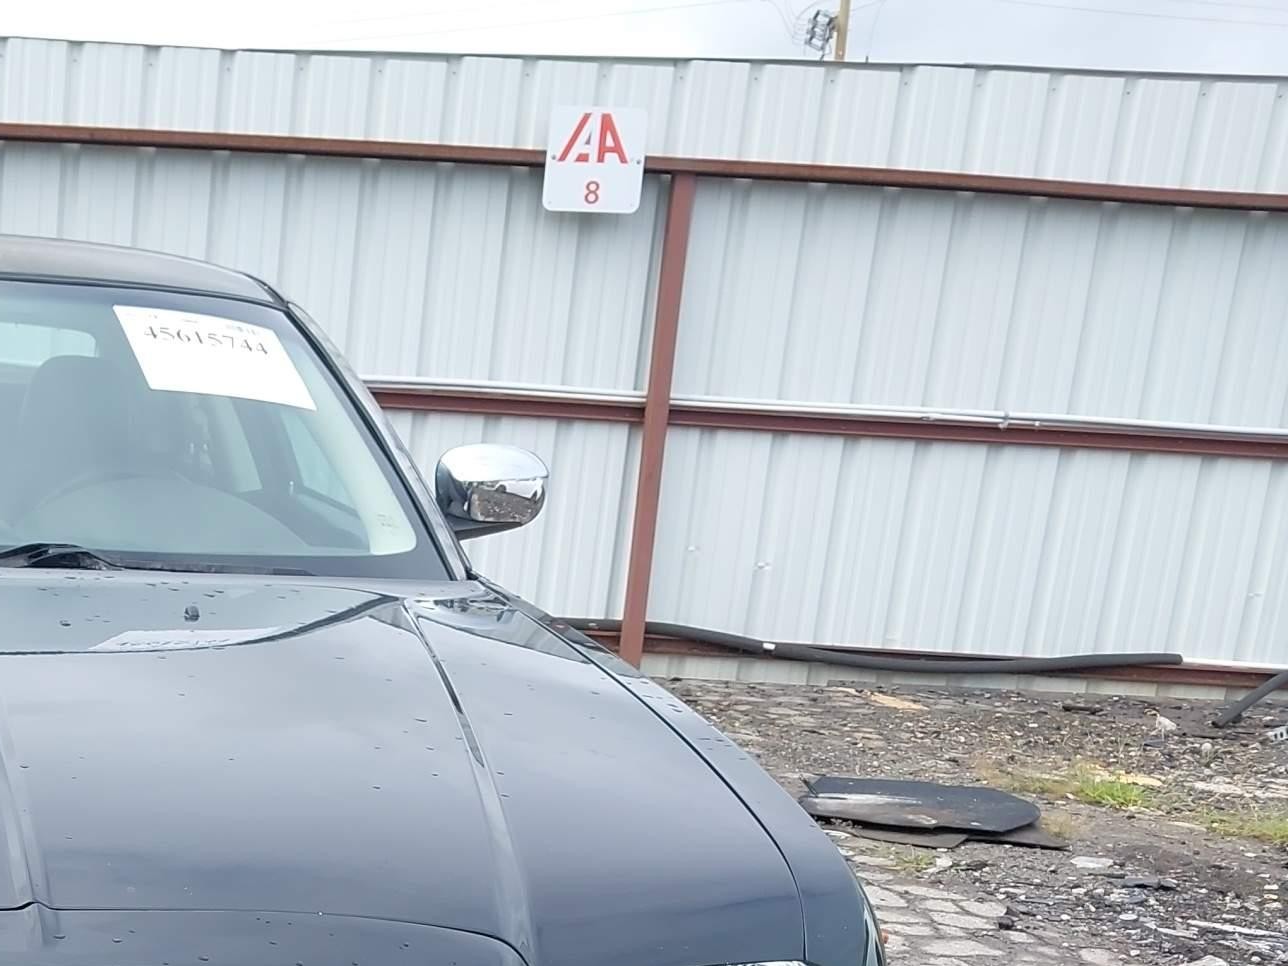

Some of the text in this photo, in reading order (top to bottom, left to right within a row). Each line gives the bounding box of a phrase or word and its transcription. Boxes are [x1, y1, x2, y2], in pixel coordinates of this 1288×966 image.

[557, 112, 629, 164] IAA
[583, 180, 600, 205] 8
[143, 325, 269, 355] 45615744
